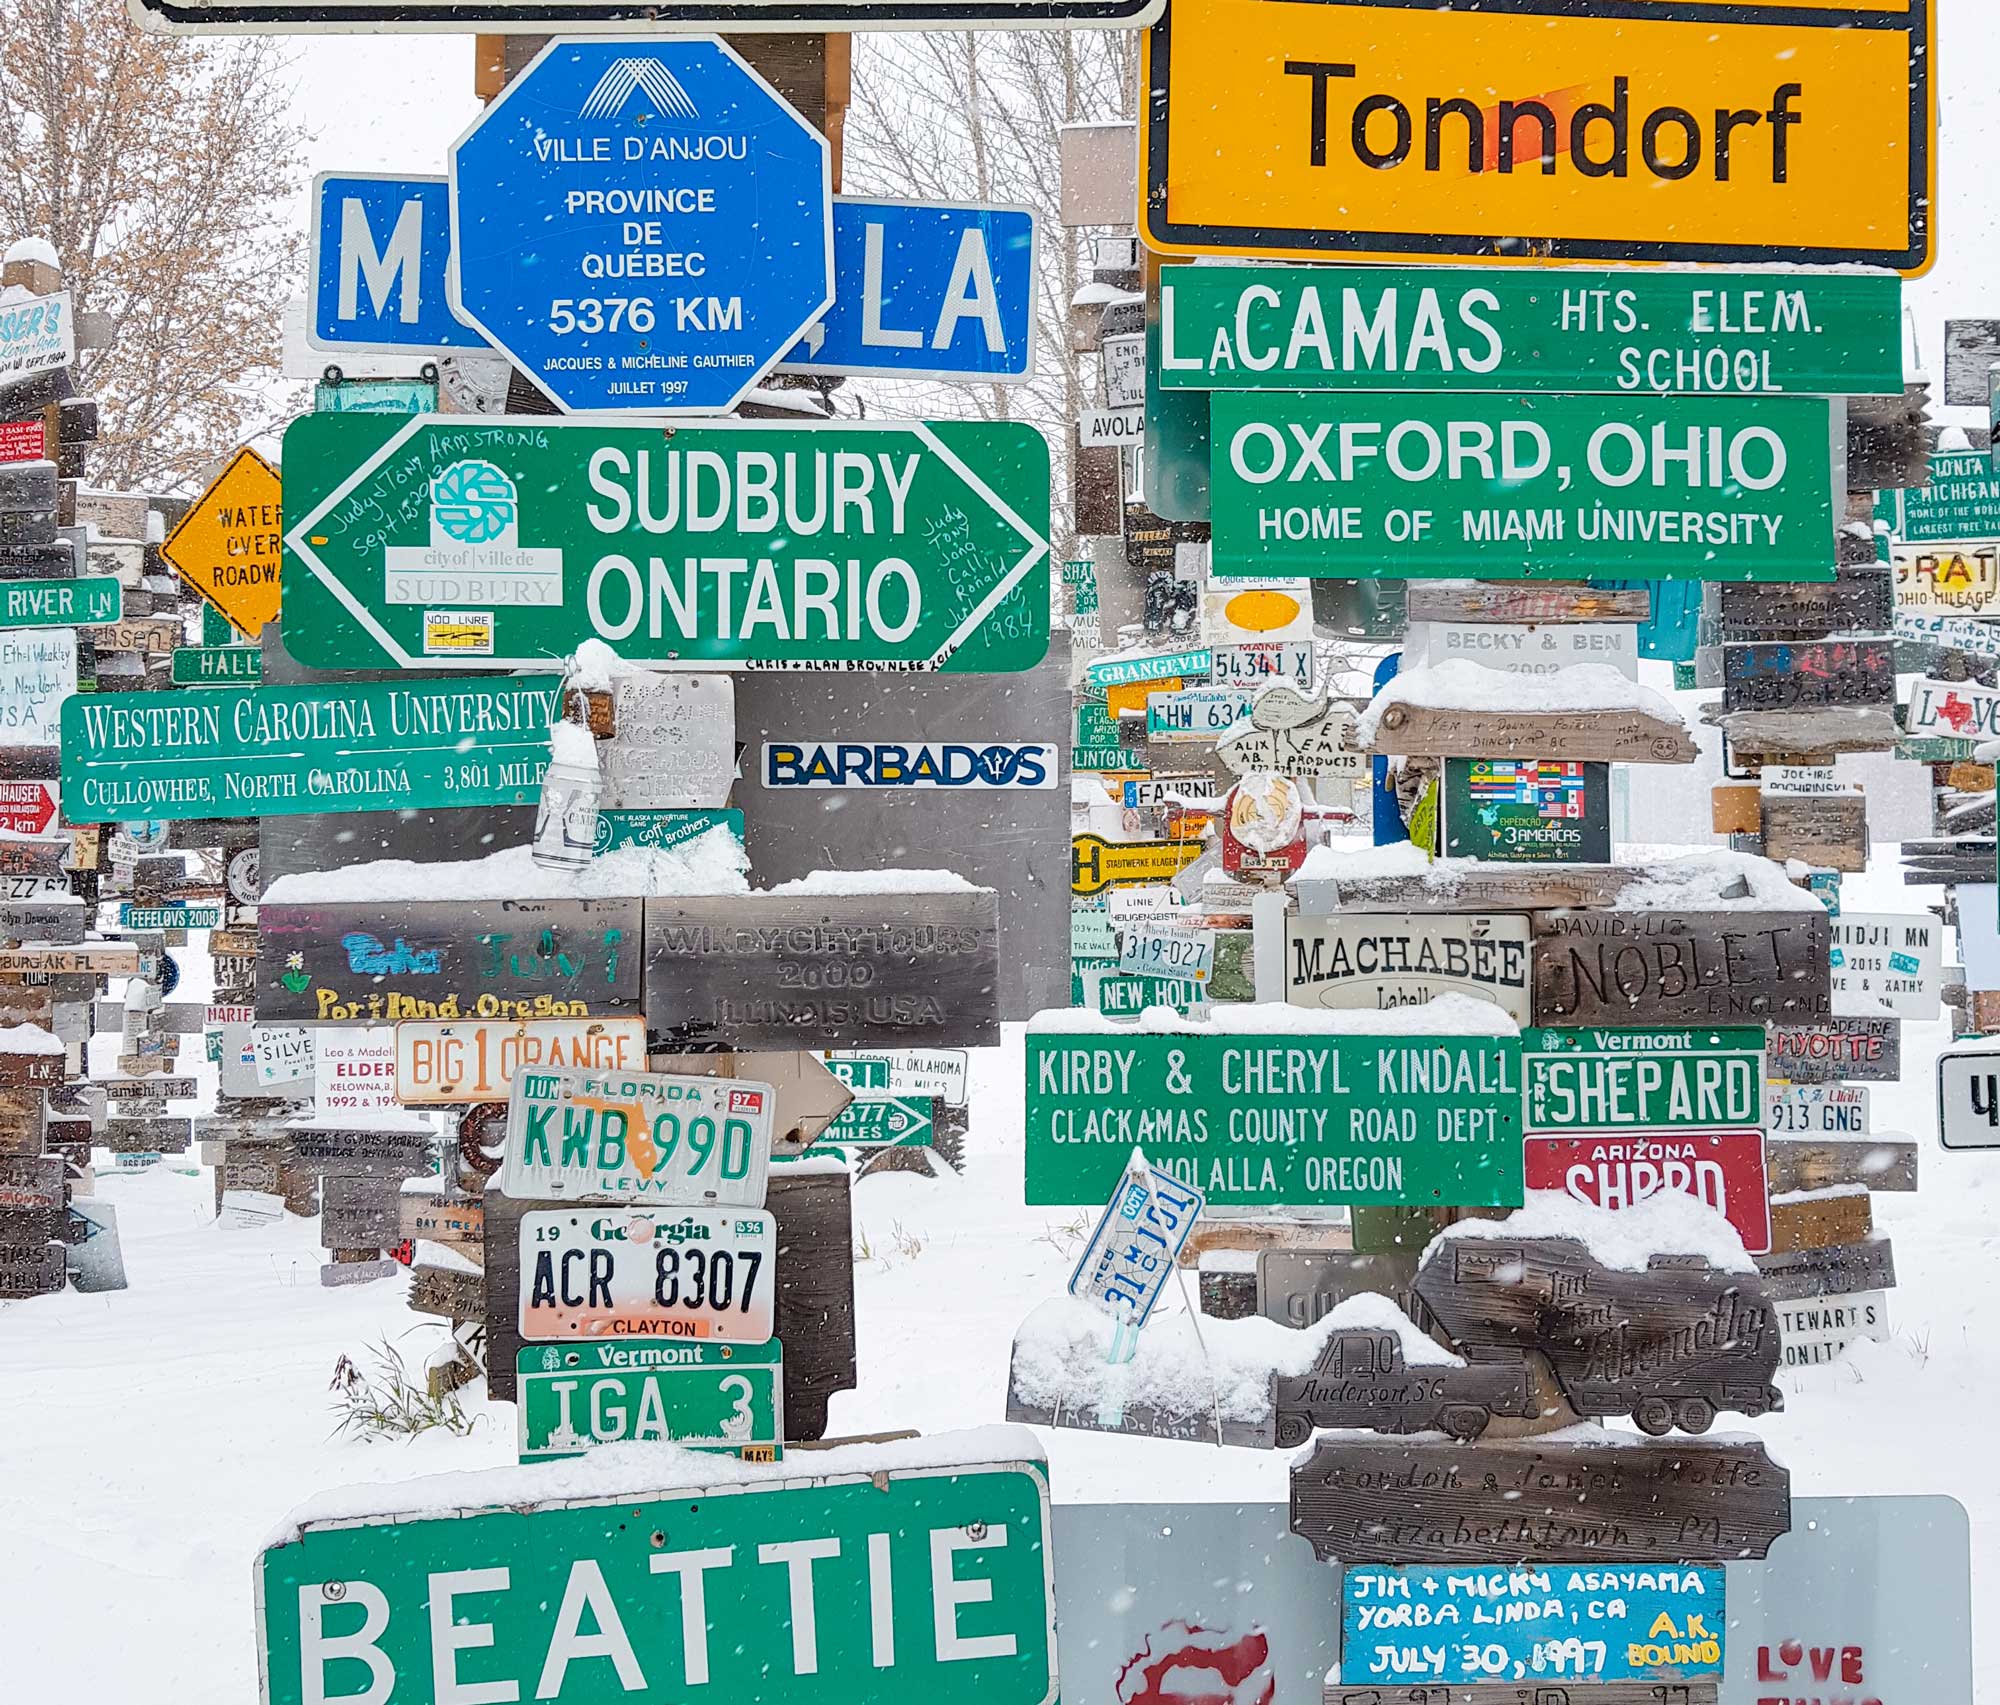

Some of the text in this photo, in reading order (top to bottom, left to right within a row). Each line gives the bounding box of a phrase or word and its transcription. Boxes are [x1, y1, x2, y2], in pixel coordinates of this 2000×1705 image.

[1283, 61, 1802, 185] Tonndorf
[533, 136, 748, 163] VILLE D'ANJOU
[567, 189, 716, 214] PROVINCE
[623, 222, 662, 246] DE
[582, 247, 707, 279] QUÉBEC
[862, 223, 1008, 353] LA
[549, 297, 744, 333] 5376 KM
[1562, 288, 1651, 335] HTS.
[1692, 289, 1824, 336] ELEM.
[543, 354, 755, 372] JACQUES & MICHELINE GAUTHIER
[1616, 346, 1785, 394] SCHOOL
[607, 381, 689, 395] JUILLET 1997
[1230, 419, 1788, 493] OXFORD, OHIO
[586, 446, 921, 536] SUDBURY
[1259, 508, 1785, 547] HOME OF MIAMI UNIVERSITY
[227, 534, 280, 556] OVER
[8, 588, 112, 617] RIVER LN
[394, 578, 553, 604] SUDBURY
[586, 554, 922, 643] ONTARIO
[458, 614, 490, 626] LIVRE
[1446, 632, 1622, 651] BECKY & BEN
[201, 652, 258, 676] HALL
[745, 658, 925, 672] CHRIS ALAN BROWNLEE
[1216, 652, 1286, 678] 54341
[82, 688, 555, 749] WESTERN CAROLINA UNIVERSITY
[768, 744, 1046, 786] BARBADOS
[1287, 755, 1357, 769] PRODUCTS
[82, 776, 217, 808] CULLOWHEE,
[224, 770, 298, 801] NORTH
[307, 766, 413, 796] CAROLINA
[443, 761, 492, 791] 3,801
[14, 816, 36, 832] km
[1504, 823, 1581, 844] 3 AMÉRICAS
[189, 912, 217, 927] 2008
[1554, 917, 1624, 938] DAVID
[661, 925, 982, 953] WINDY CITY TOURS
[1126, 935, 1207, 968] 319-027
[1905, 928, 1930, 947] MN
[1292, 925, 1526, 988] MACHABÉE
[1555, 927, 1792, 1014] NOBLET
[1851, 958, 1882, 971] 2015
[777, 961, 875, 989] 2000
[1885, 979, 1924, 993] KATHY
[476, 992, 590, 1020] Oregon
[1103, 981, 1144, 1010] NEW
[1707, 994, 1829, 1017] ENGLAND
[207, 1008, 252, 1023] MARIE
[864, 996, 945, 1026] USA
[261, 1031, 291, 1042] Dave
[1594, 1029, 1692, 1052] Vermont
[1777, 1031, 1885, 1062] MYOTTE
[412, 1028, 632, 1092] BIG 1 ORANGE
[907, 1058, 961, 1076] OKLAHOMA
[1039, 1048, 1517, 1096] KIRBY & CHERYL KINDALL
[326, 1096, 357, 1108] 1992
[526, 1076, 704, 1102] JUN FLORIDA
[732, 1092, 750, 1107] 97
[1549, 1059, 1752, 1122] SHEPARD
[1051, 1108, 1208, 1144] CLACKAMAS
[1228, 1107, 1329, 1144] COUNTY
[1349, 1107, 1417, 1143] ROAD
[1772, 1104, 1862, 1132] 913 GNG
[652, 1112, 754, 1181] 99D
[824, 1126, 883, 1140] MILES
[1591, 1142, 1697, 1161] ARIZONA
[601, 1177, 669, 1193] LEVY
[1305, 1155, 1402, 1192] OREGON
[535, 1226, 561, 1243] 19
[531, 1247, 763, 1313] ACR 8307
[612, 1319, 697, 1337] CLAYTON
[597, 1344, 705, 1369] Vermont
[547, 1373, 756, 1447] IGA 3
[1354, 1571, 1706, 1597] JIM + MICKY ASAYAMA
[298, 1522, 1019, 1705] BEATTIE
[1357, 1598, 1627, 1630] YORBA LINDA, CA
[1648, 1612, 1718, 1640] A.K.
[1369, 1638, 1608, 1680] JULY 30, 1997
[1628, 1640, 1721, 1667] BOUND
[1757, 1643, 1865, 1686] LOVE
